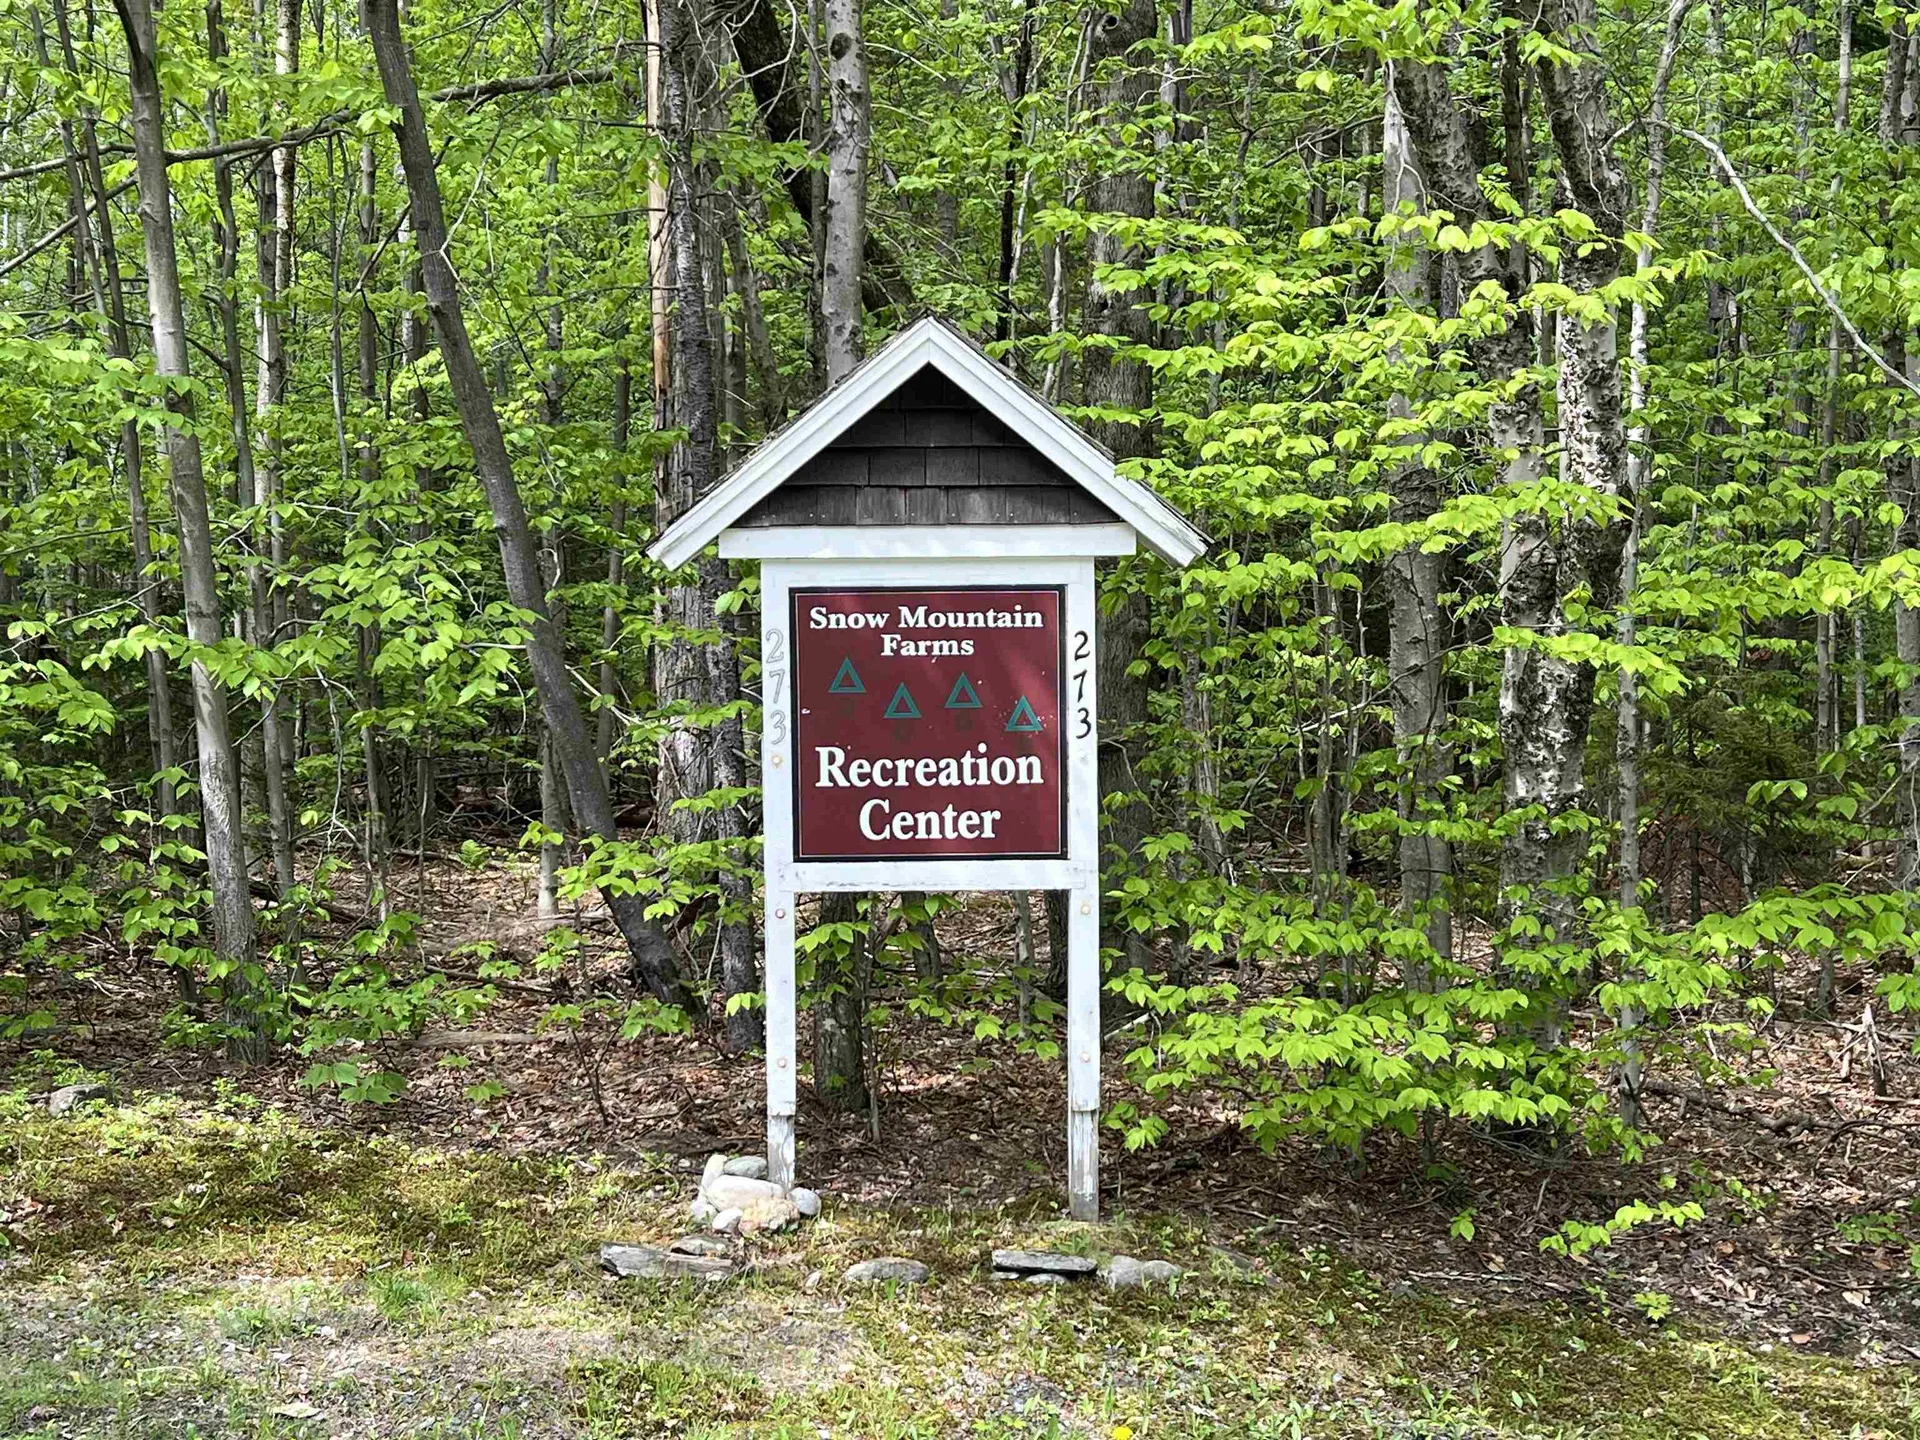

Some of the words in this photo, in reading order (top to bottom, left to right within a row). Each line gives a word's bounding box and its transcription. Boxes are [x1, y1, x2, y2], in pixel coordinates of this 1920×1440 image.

[809, 606, 890, 629] Snow
[897, 604, 1044, 628] Mountain
[880, 633, 975, 656] Farms
[765, 628, 787, 745] 273
[1072, 630, 1092, 739] 273
[814, 742, 1044, 788] Recreation
[859, 799, 1001, 841] Center
